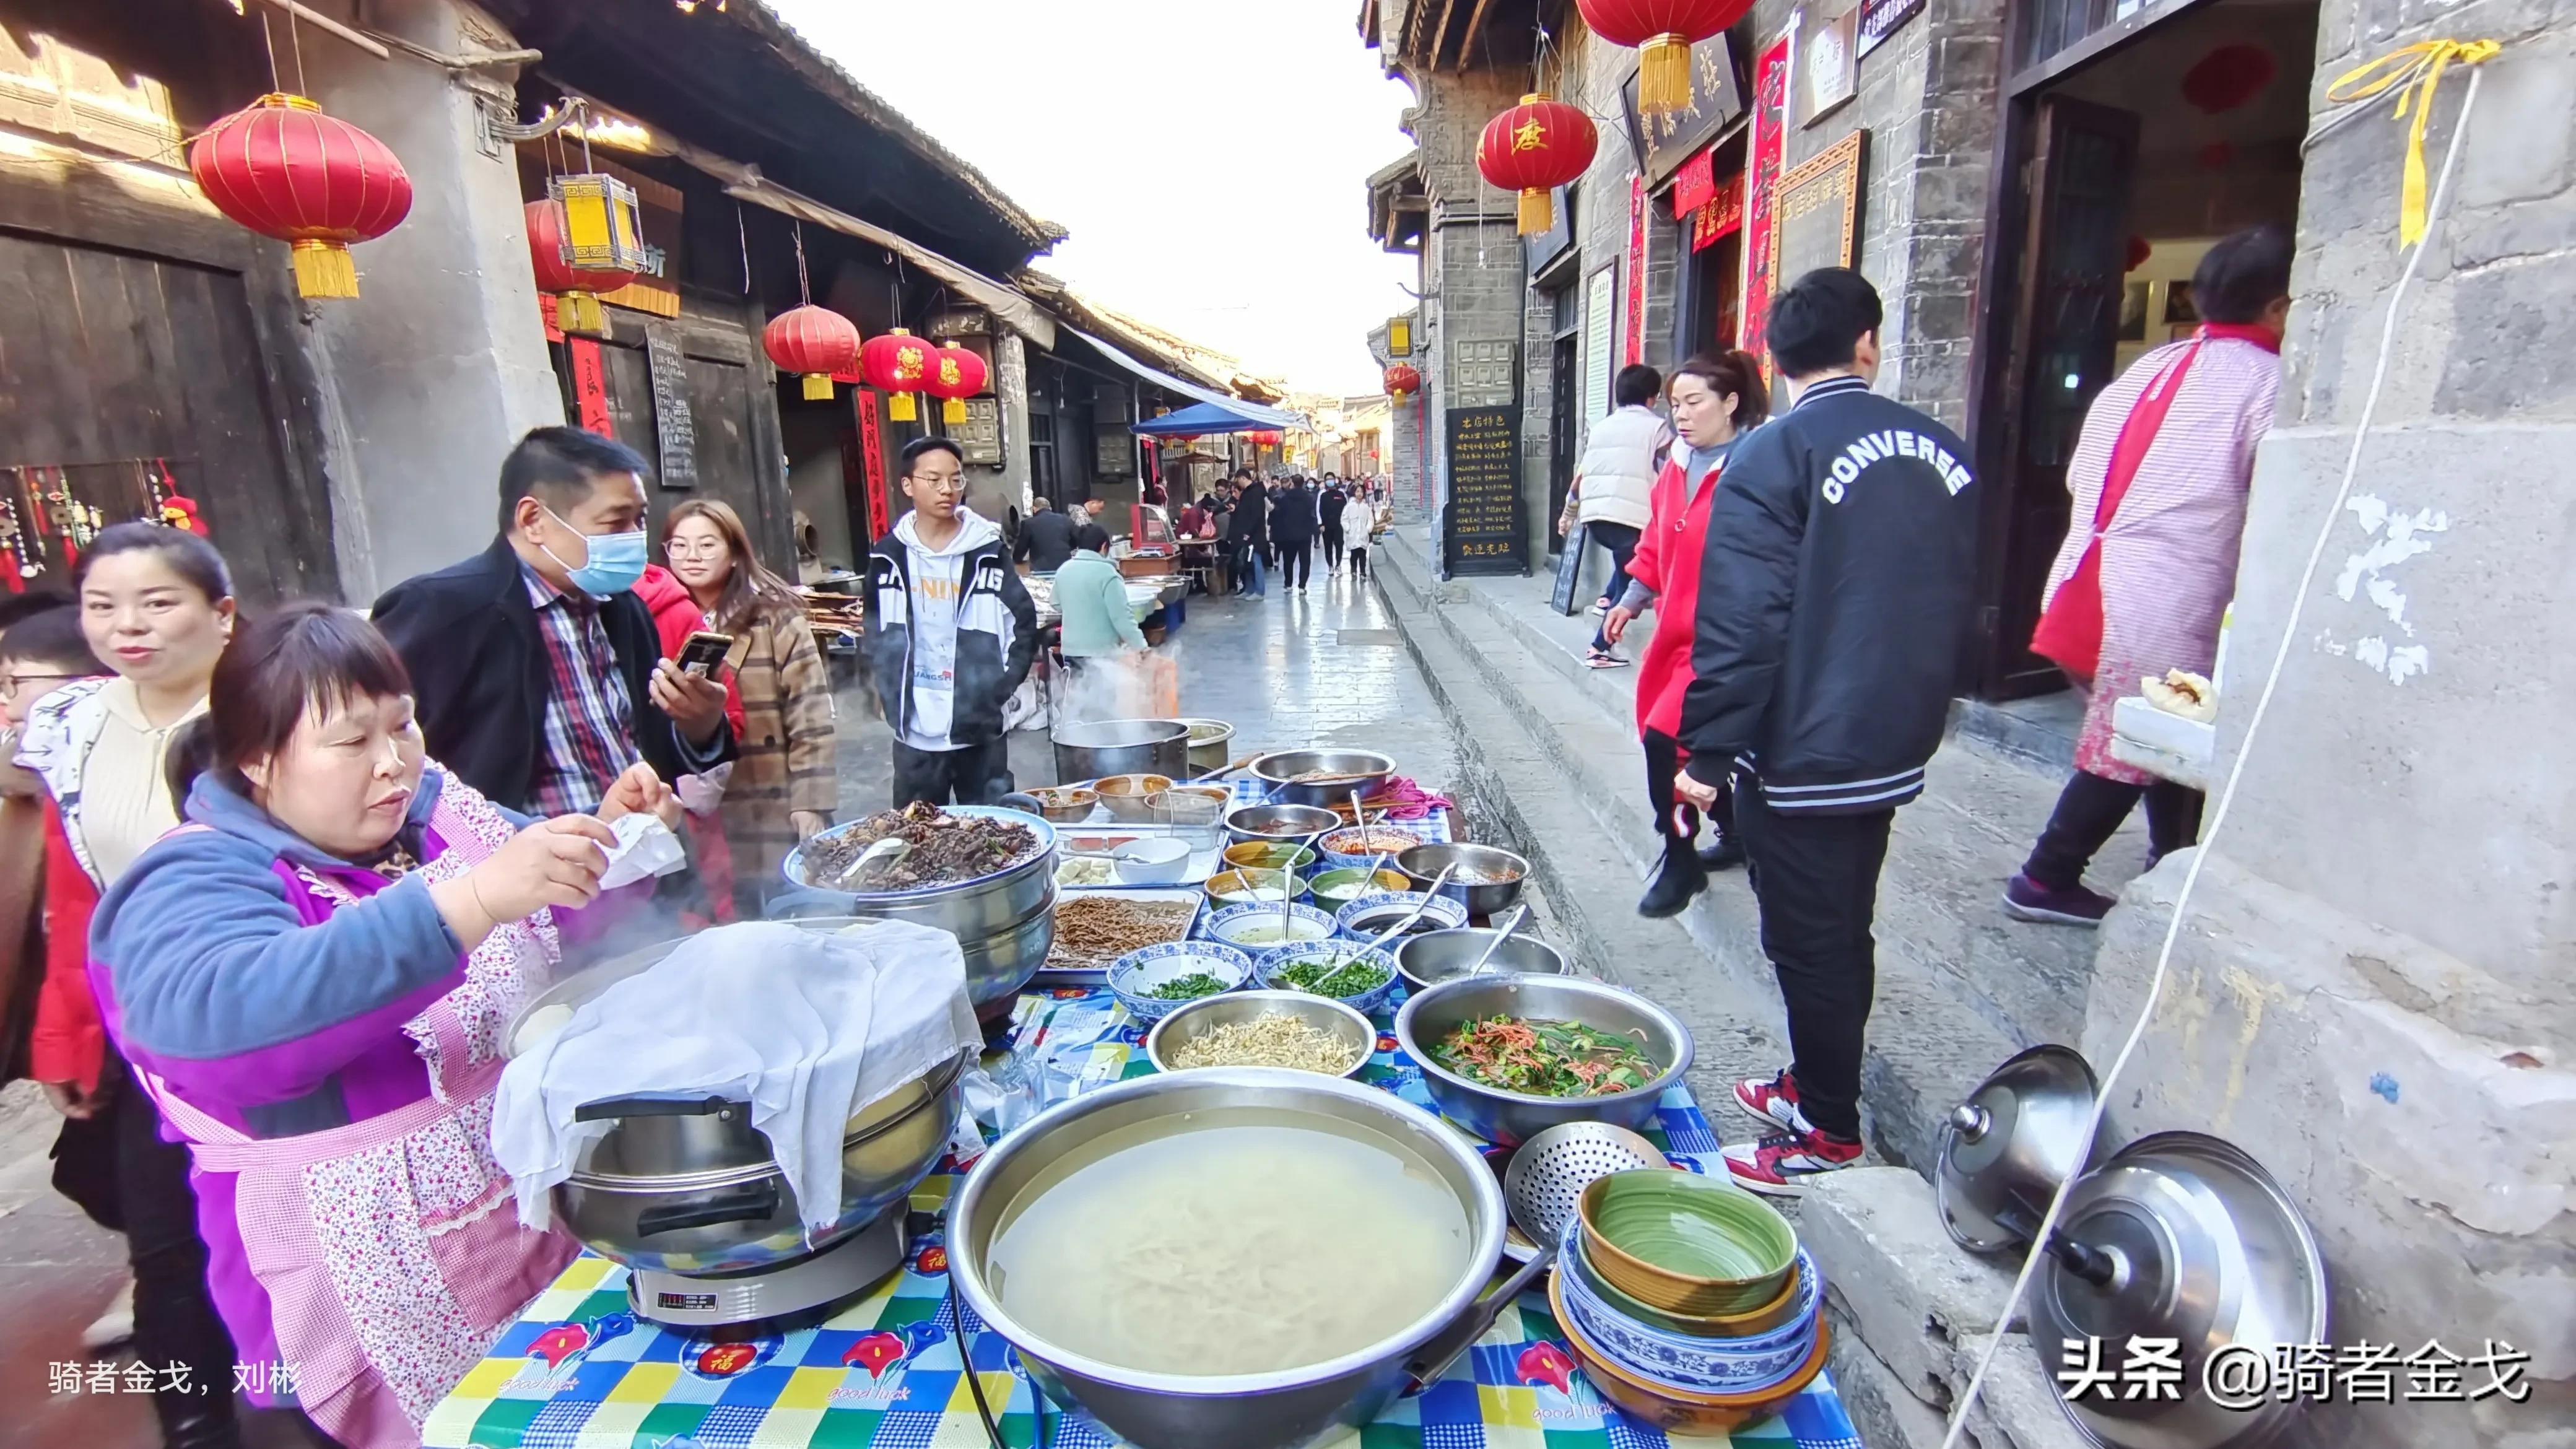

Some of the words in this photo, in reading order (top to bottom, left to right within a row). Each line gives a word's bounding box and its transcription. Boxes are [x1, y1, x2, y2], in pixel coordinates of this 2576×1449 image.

[1512, 118, 1548, 155] 度
[1461, 415, 1505, 429] 本店特色
[1822, 430, 1972, 505] CONVERSE
[710, 1354, 737, 1370] 福
[827, 1387, 872, 1401] good
[1533, 1404, 1576, 1422] good
